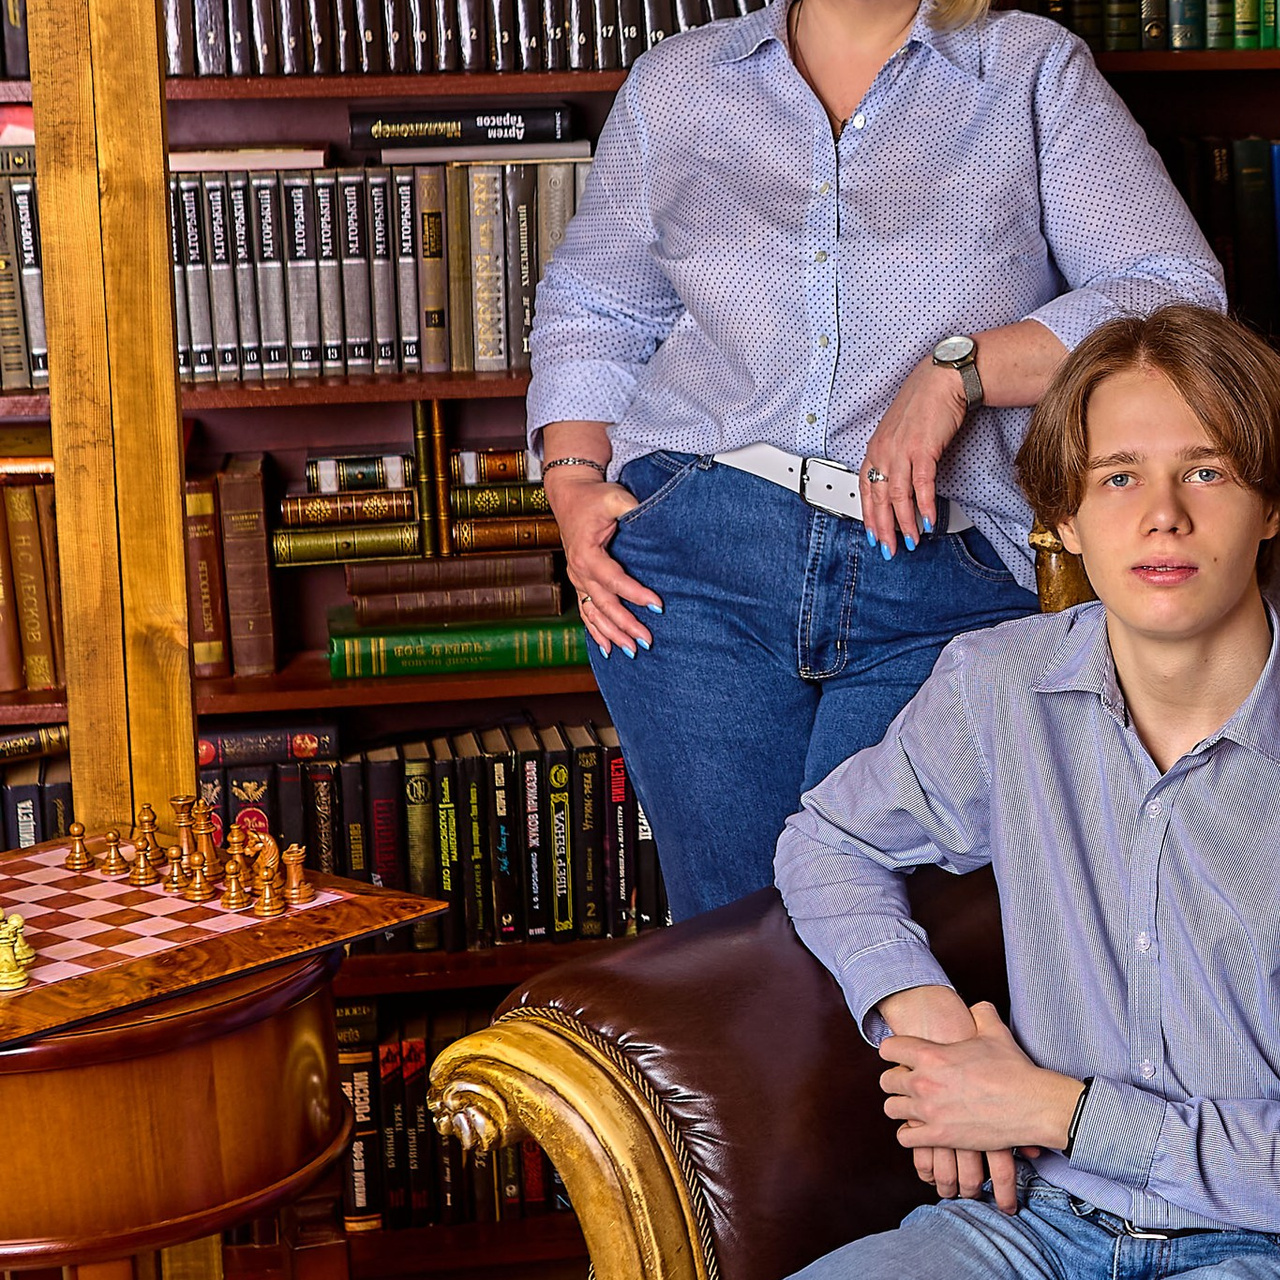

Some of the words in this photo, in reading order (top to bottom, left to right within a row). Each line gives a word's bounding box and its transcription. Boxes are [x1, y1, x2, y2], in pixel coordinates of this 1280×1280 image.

[208, 33, 215, 44] 2
[365, 30, 372, 42] 8
[393, 32, 399, 42] 9
[601, 27, 613, 38] 17
[623, 26, 637, 38] 18
[650, 31, 664, 42] 19
[476, 113, 524, 128] Тарасов
[371, 121, 461, 138] Миллионер
[488, 128, 525, 140] Артем
[518, 204, 529, 286] ХМЕЛЬНИЦКИЙ
[431, 313, 439, 324] 3
[225, 353, 232, 361] 9
[247, 353, 256, 361] 10
[271, 351, 279, 360] 11
[302, 350, 312, 360] 12
[328, 348, 338, 359] 13
[354, 347, 364, 357] 14
[381, 347, 391, 357] 15
[405, 346, 416, 356] 16
[200, 354, 207, 364] 8
[21, 576, 42, 643] ЛЕСКОВ
[526, 760, 539, 812] ПРИКАЗАЛ!
[611, 758, 625, 802] НИЩЕТА
[17, 800, 35, 849] НИЩЕТА
[528, 813, 540, 849] ЖУКОВ
[439, 809, 450, 867] ДЛИННОНОГИХ
[448, 809, 458, 861] МАНЕКЕНЩИЦ
[554, 811, 565, 855] БЕНУА
[443, 868, 451, 891] ДЕЛО
[556, 859, 567, 896] ПЬЕР
[586, 902, 596, 917] 2
[353, 1071, 371, 1122] РОССИИ
[353, 1141, 365, 1170] ШЕФОВ
[352, 1172, 367, 1207] НИКОЛАЙ
